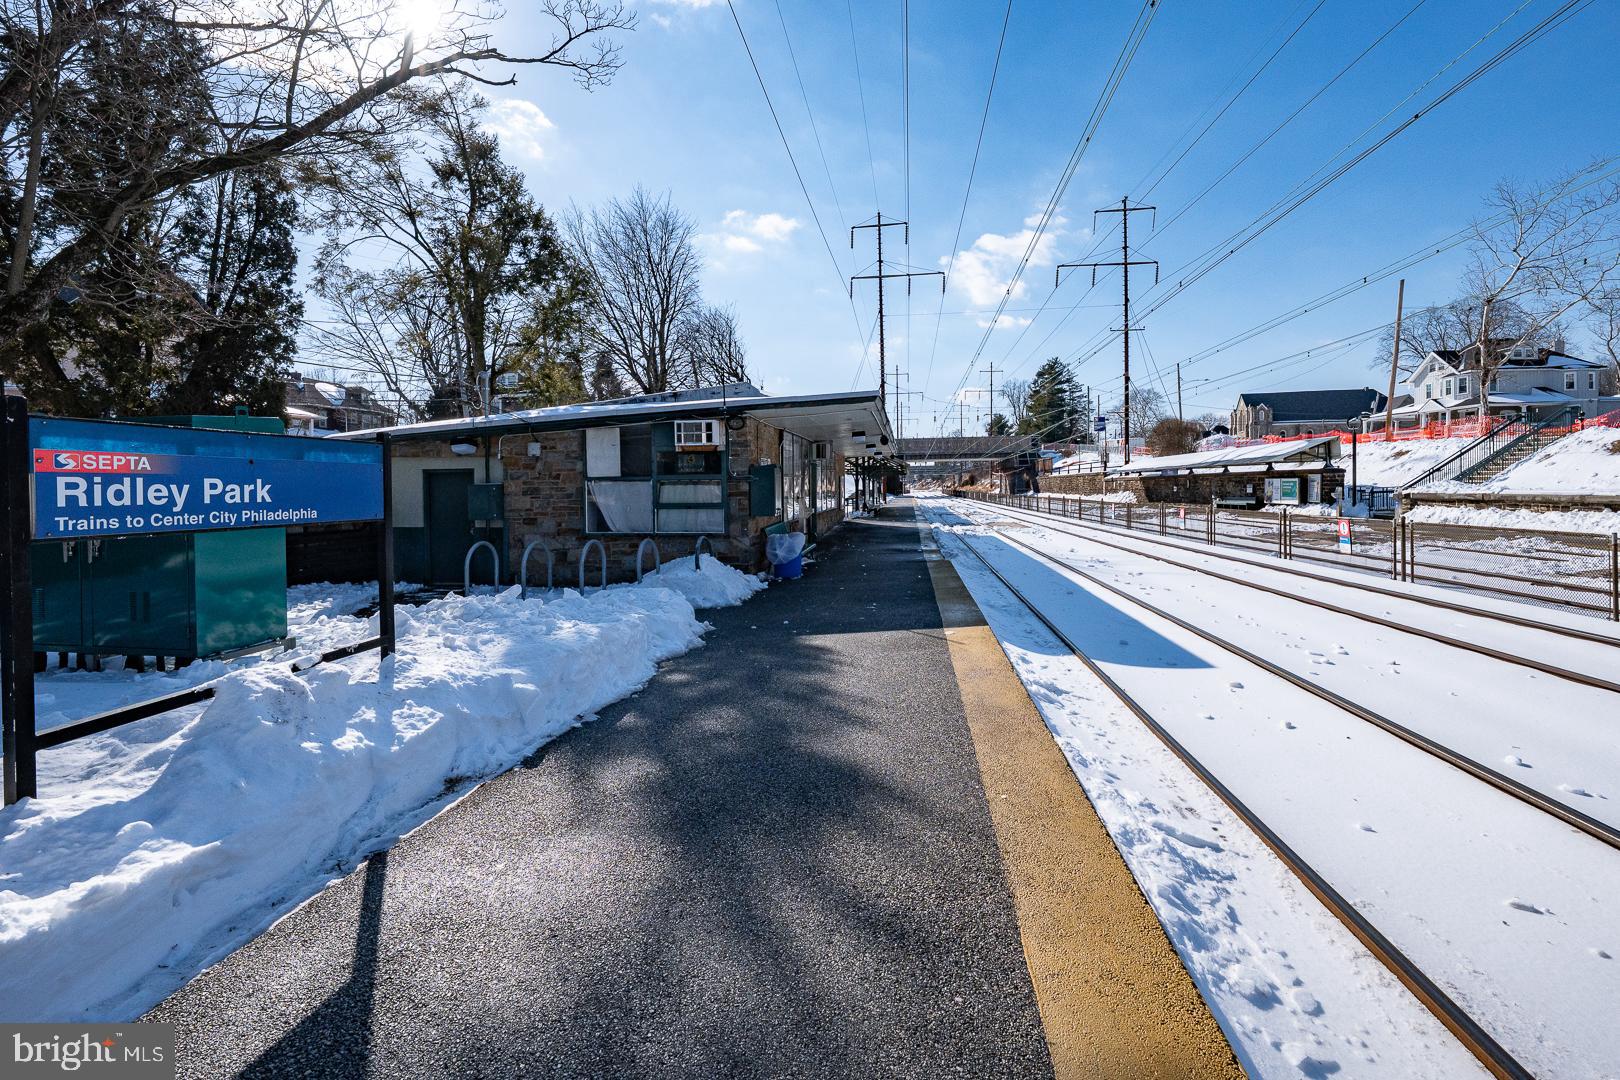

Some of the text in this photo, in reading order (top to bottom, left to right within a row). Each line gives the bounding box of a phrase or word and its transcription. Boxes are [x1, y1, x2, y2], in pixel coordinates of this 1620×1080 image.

[82, 454, 151, 471] SEPTA
[56, 476, 272, 512] Ridley Park
[54, 508, 318, 532] Trains to Center City Philadelphia
